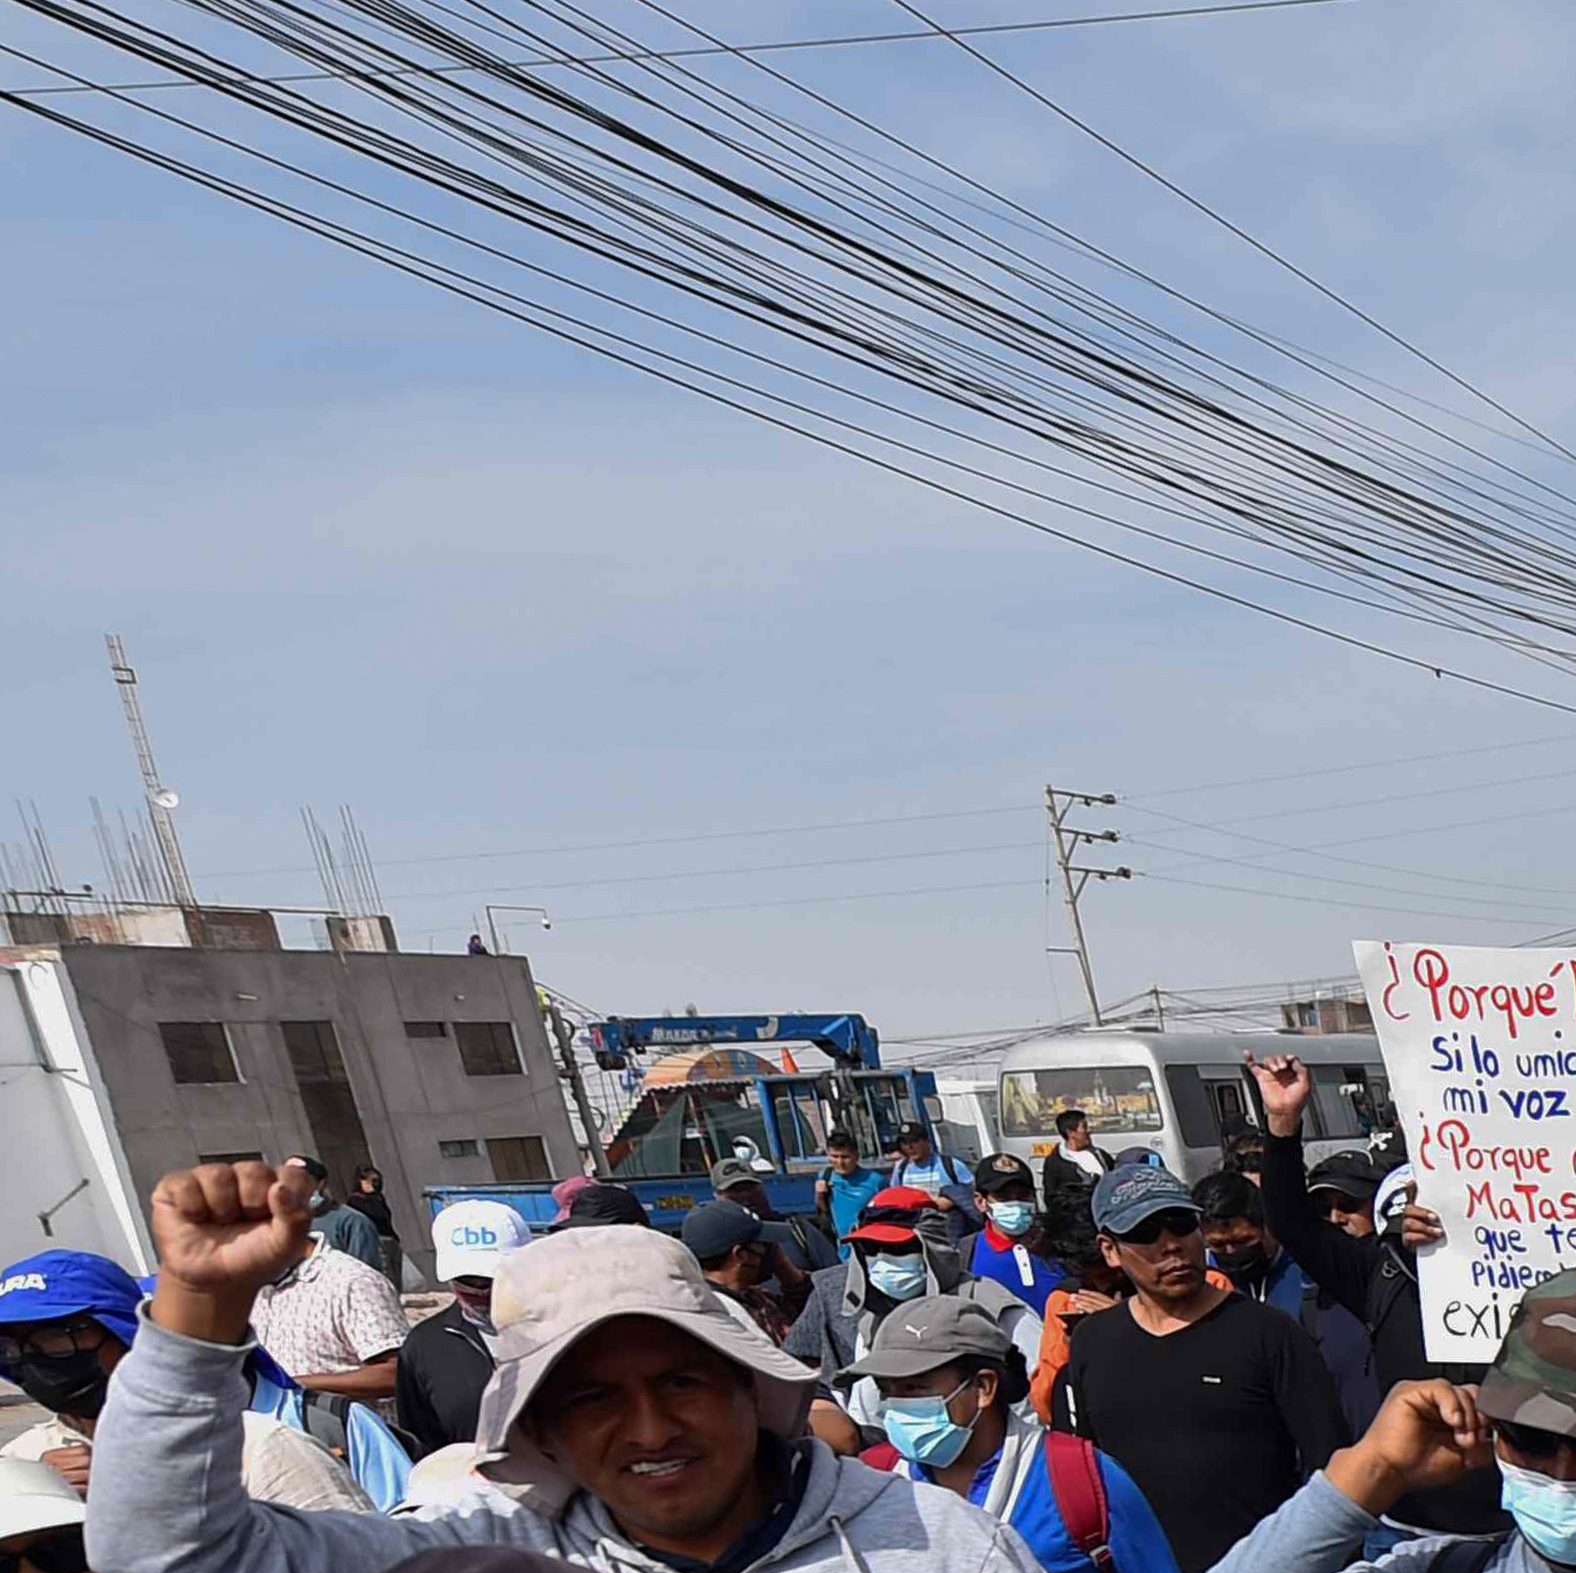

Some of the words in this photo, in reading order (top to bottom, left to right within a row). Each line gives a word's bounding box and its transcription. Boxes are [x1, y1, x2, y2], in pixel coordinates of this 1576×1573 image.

[1383, 941, 1565, 1039] ¿Porqué
[1430, 1032, 1464, 1072] Si
[1470, 1034, 1500, 1078] lo
[1443, 1078, 1489, 1115] mi
[1498, 1089, 1571, 1120] voz
[1419, 1111, 1552, 1181] ¿Porque
[451, 1226, 497, 1246] Cbb
[1474, 1225, 1528, 1261] que
[0, 1274, 47, 1296] RA
